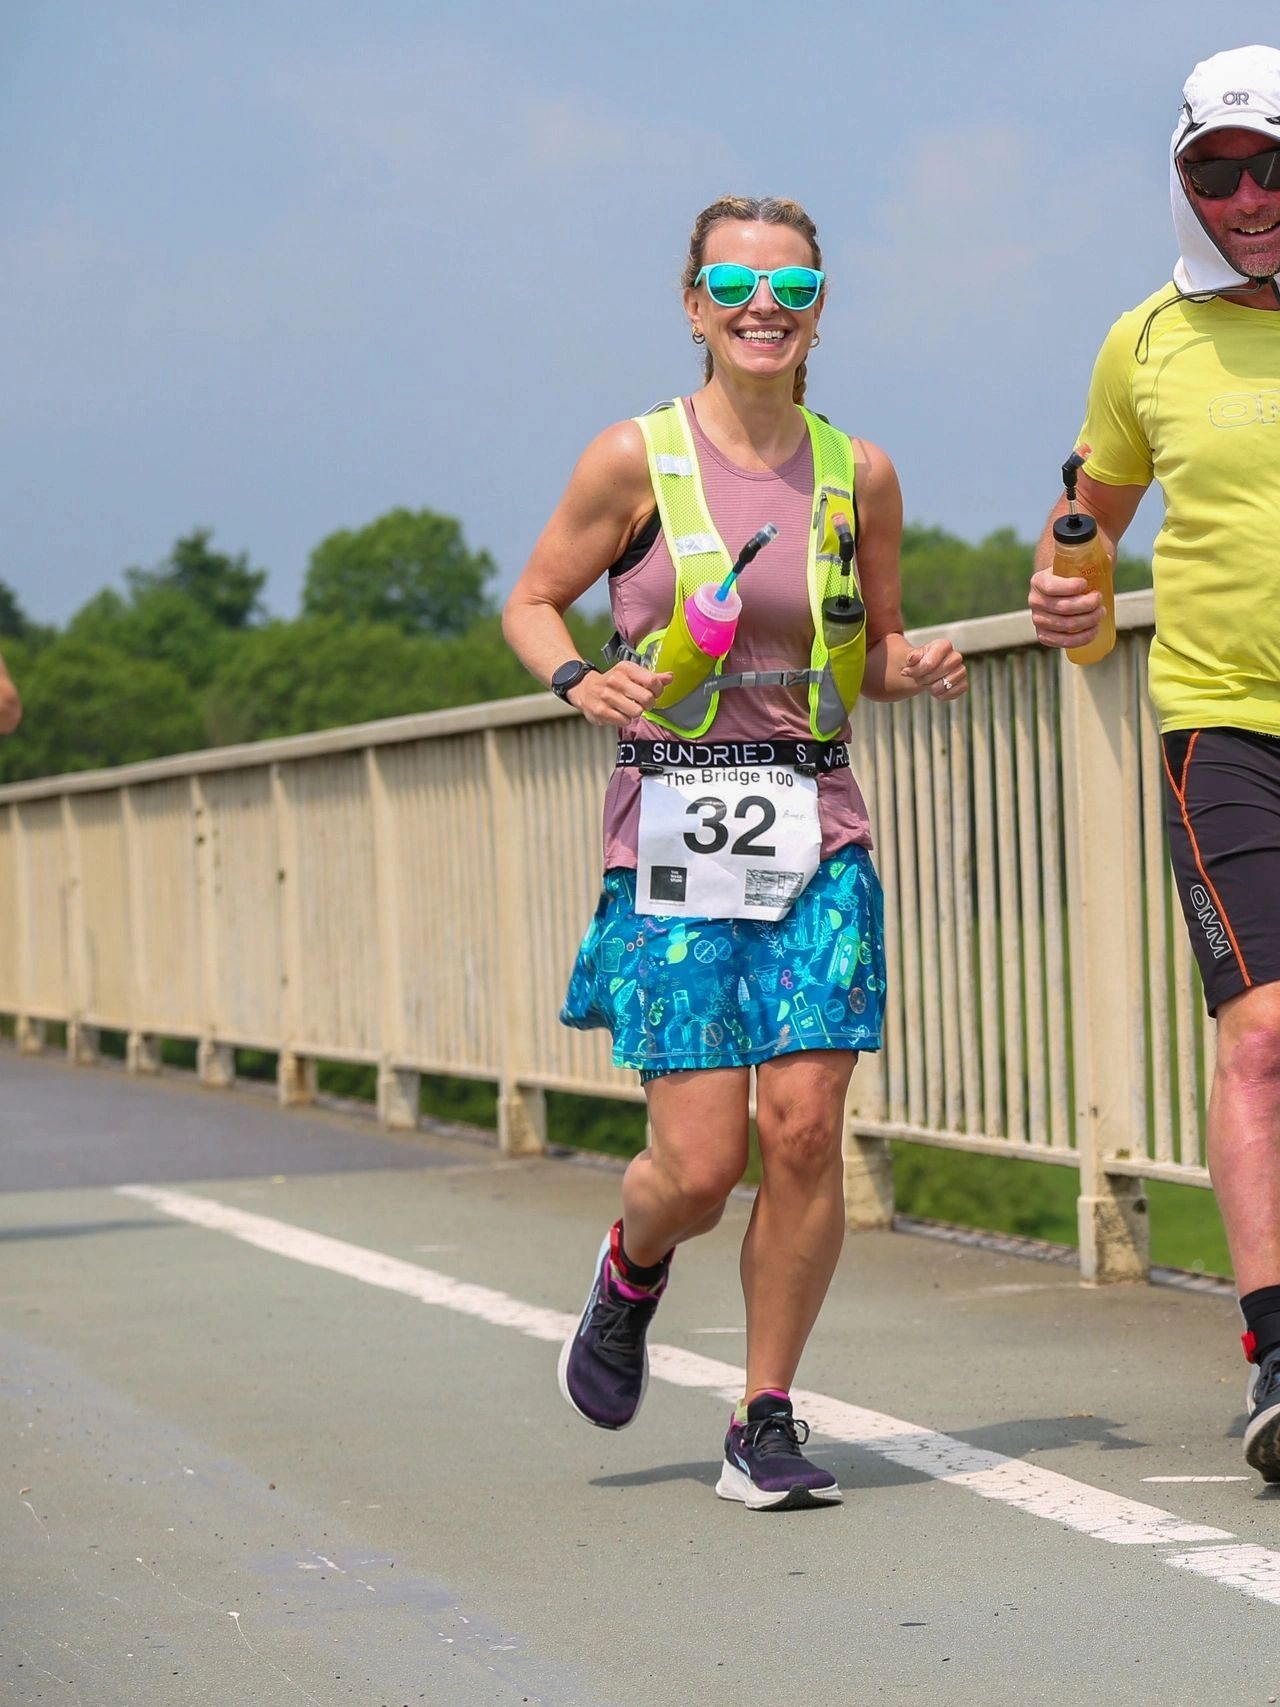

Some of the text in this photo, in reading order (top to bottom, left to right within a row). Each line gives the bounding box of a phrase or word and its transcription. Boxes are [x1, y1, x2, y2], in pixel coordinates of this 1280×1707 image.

[1222, 91, 1250, 106] OR
[652, 742, 775, 766] SUNDRIED
[663, 767, 794, 788] The Bridge 100
[683, 795, 776, 857] 32
[1189, 884, 1232, 960] OMM
